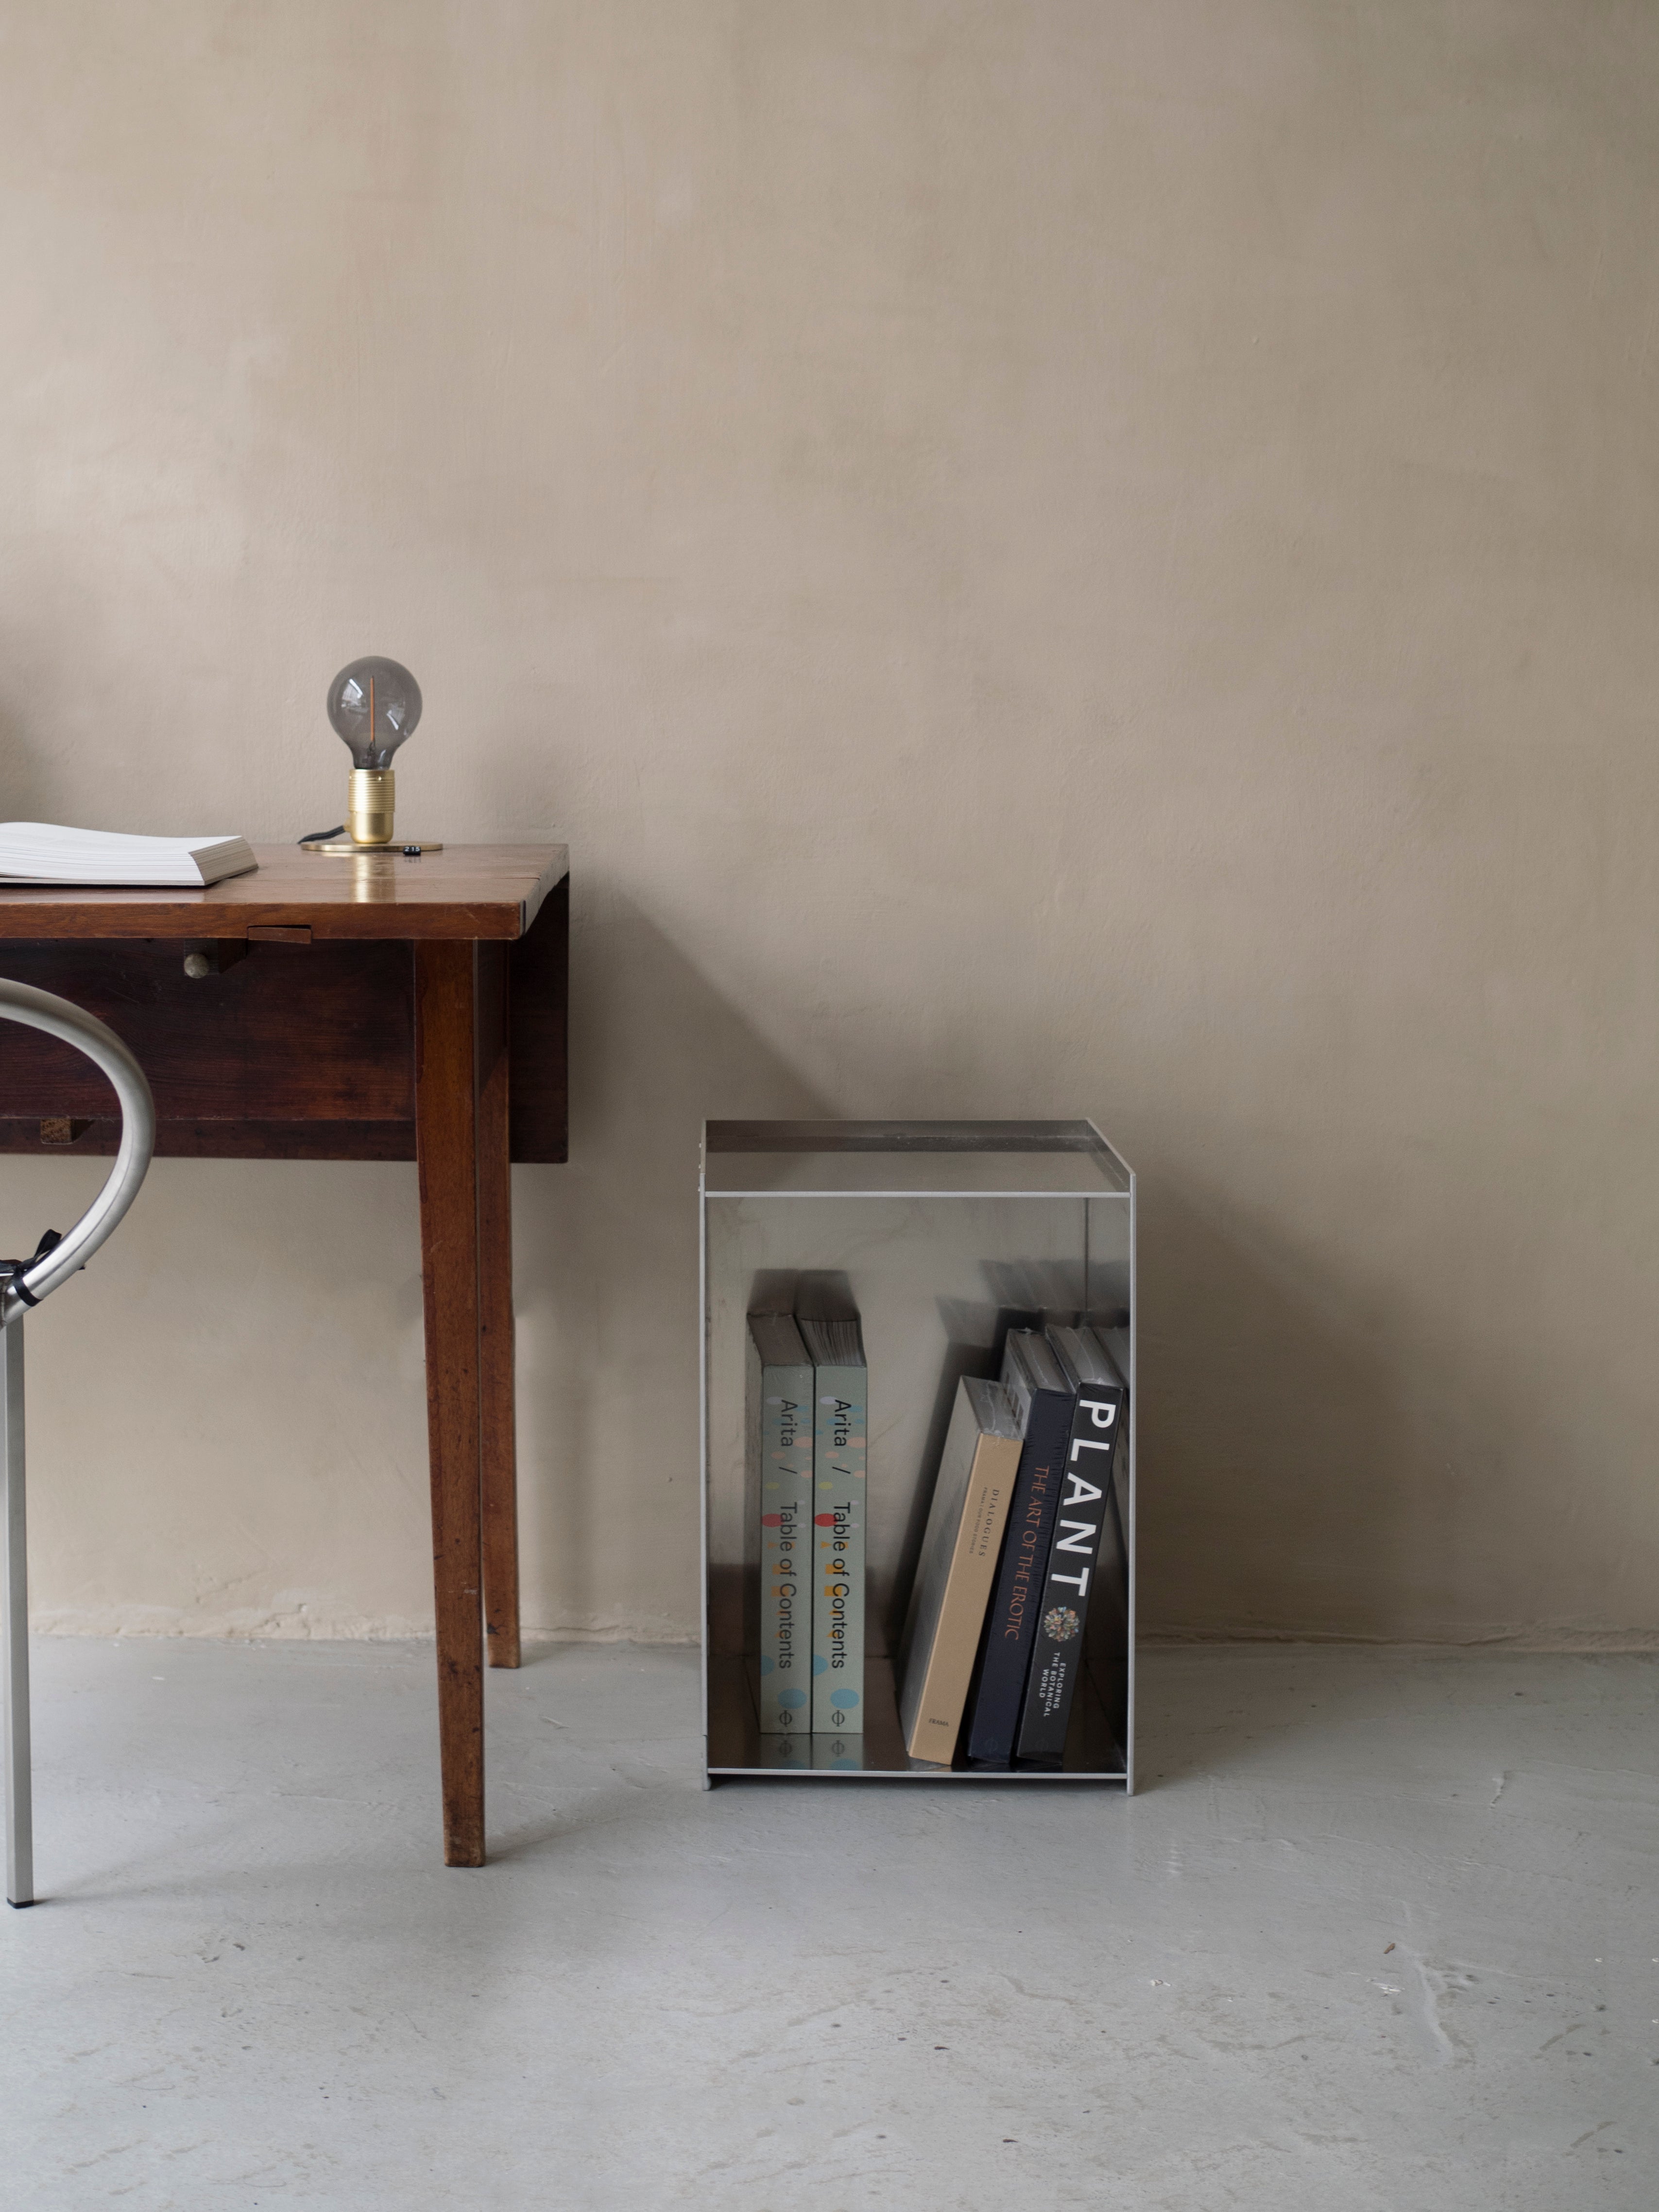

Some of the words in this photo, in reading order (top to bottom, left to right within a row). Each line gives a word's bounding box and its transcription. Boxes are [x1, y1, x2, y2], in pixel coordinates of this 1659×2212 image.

[781, 1399, 798, 1446] Arita
[834, 1399, 852, 1446] Arita
[1031, 1465, 1049, 1494] THE
[1051, 1399, 1116, 1597] PLANT
[780, 1501, 797, 1551] Table
[833, 1501, 850, 1551] Table
[978, 1489, 999, 1557] DIALOGUES
[1026, 1496, 1043, 1528] ART
[1021, 1530, 1037, 1552] OF
[780, 1558, 797, 1577] of
[833, 1558, 850, 1577] of
[1014, 1554, 1034, 1582] THE
[779, 1582, 797, 1669] Contents
[832, 1582, 850, 1669] Contents
[1004, 1585, 1028, 1641] EROTIC
[1039, 1668, 1050, 1698] WORLD
[1051, 1652, 1060, 1668] THE
[1043, 1670, 1057, 1717] BOTANICAL
[1053, 1663, 1066, 1709] EXPLORING
